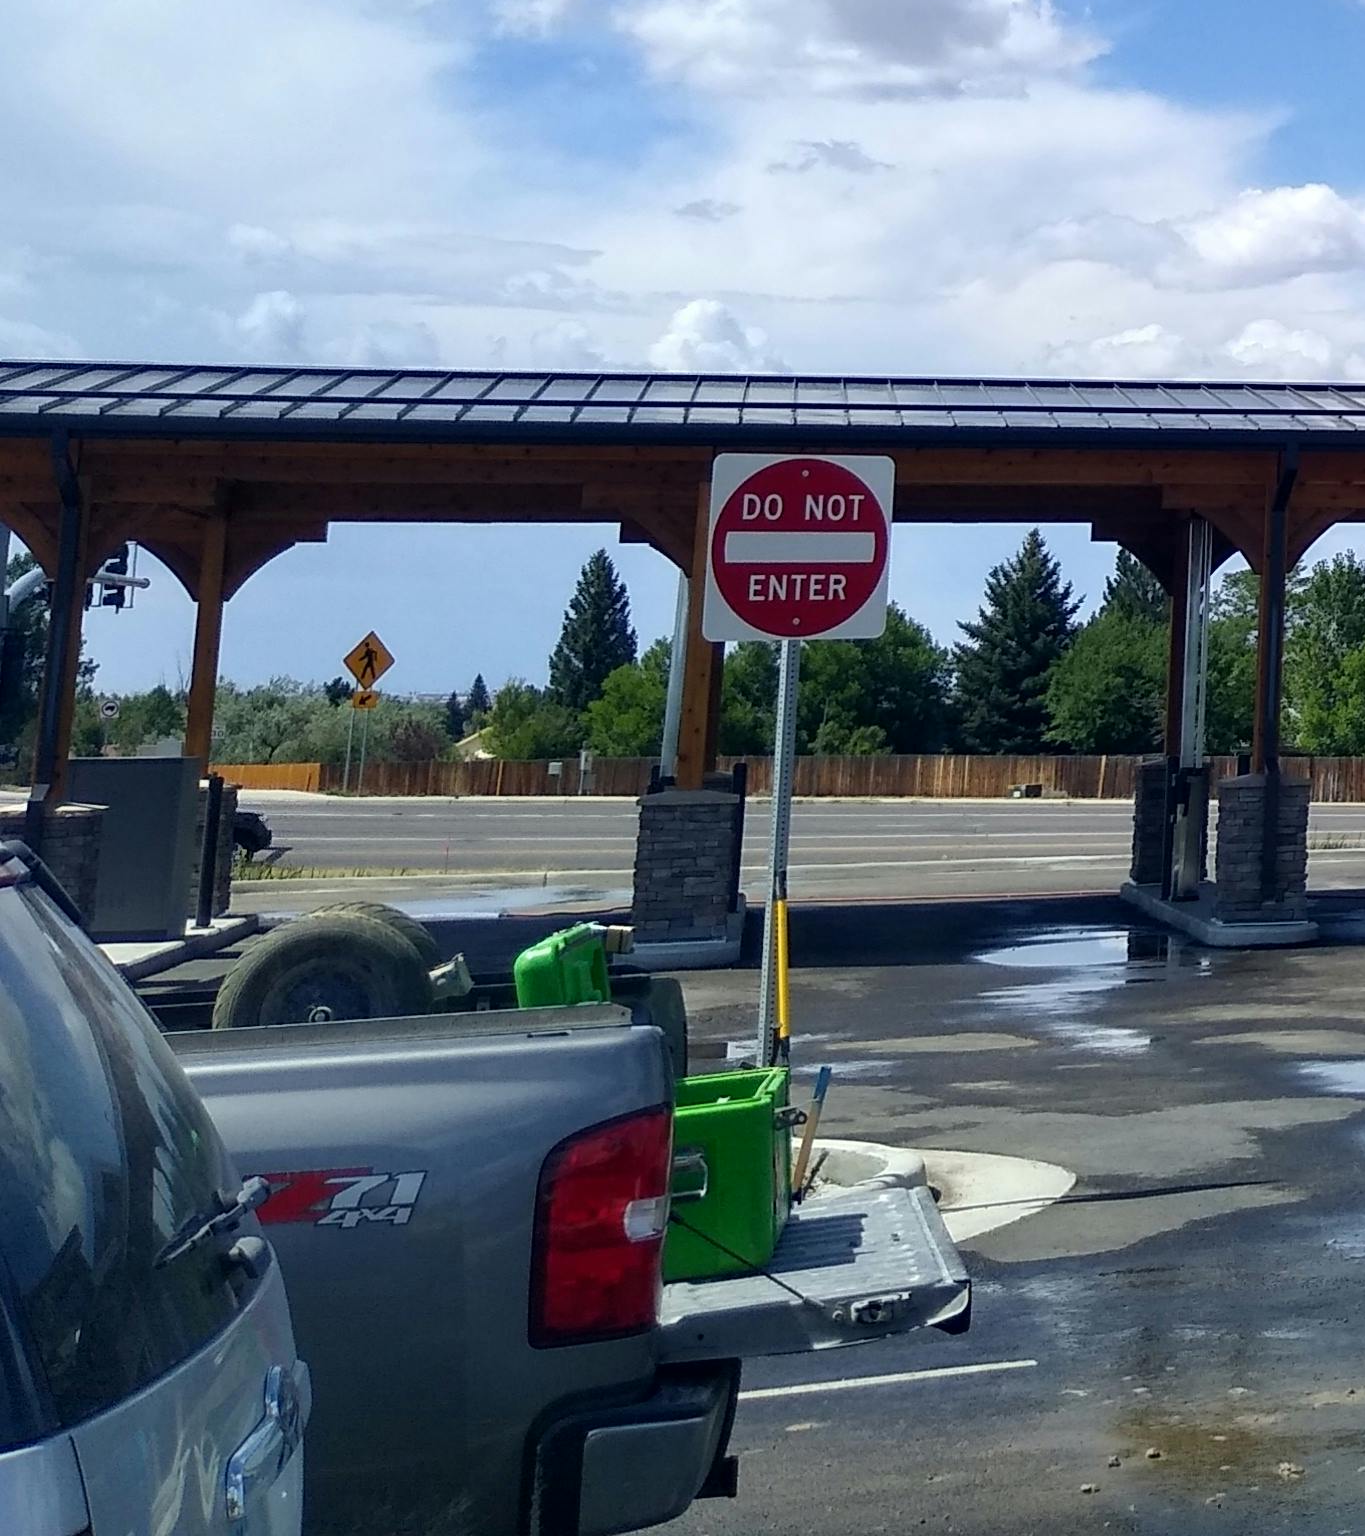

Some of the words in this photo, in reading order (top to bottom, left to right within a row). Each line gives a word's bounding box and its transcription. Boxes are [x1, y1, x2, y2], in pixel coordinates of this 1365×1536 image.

[742, 493, 783, 521] DO
[805, 494, 865, 521] NOT
[749, 574, 847, 601] ENTER
[255, 1166, 428, 1226] Z71
